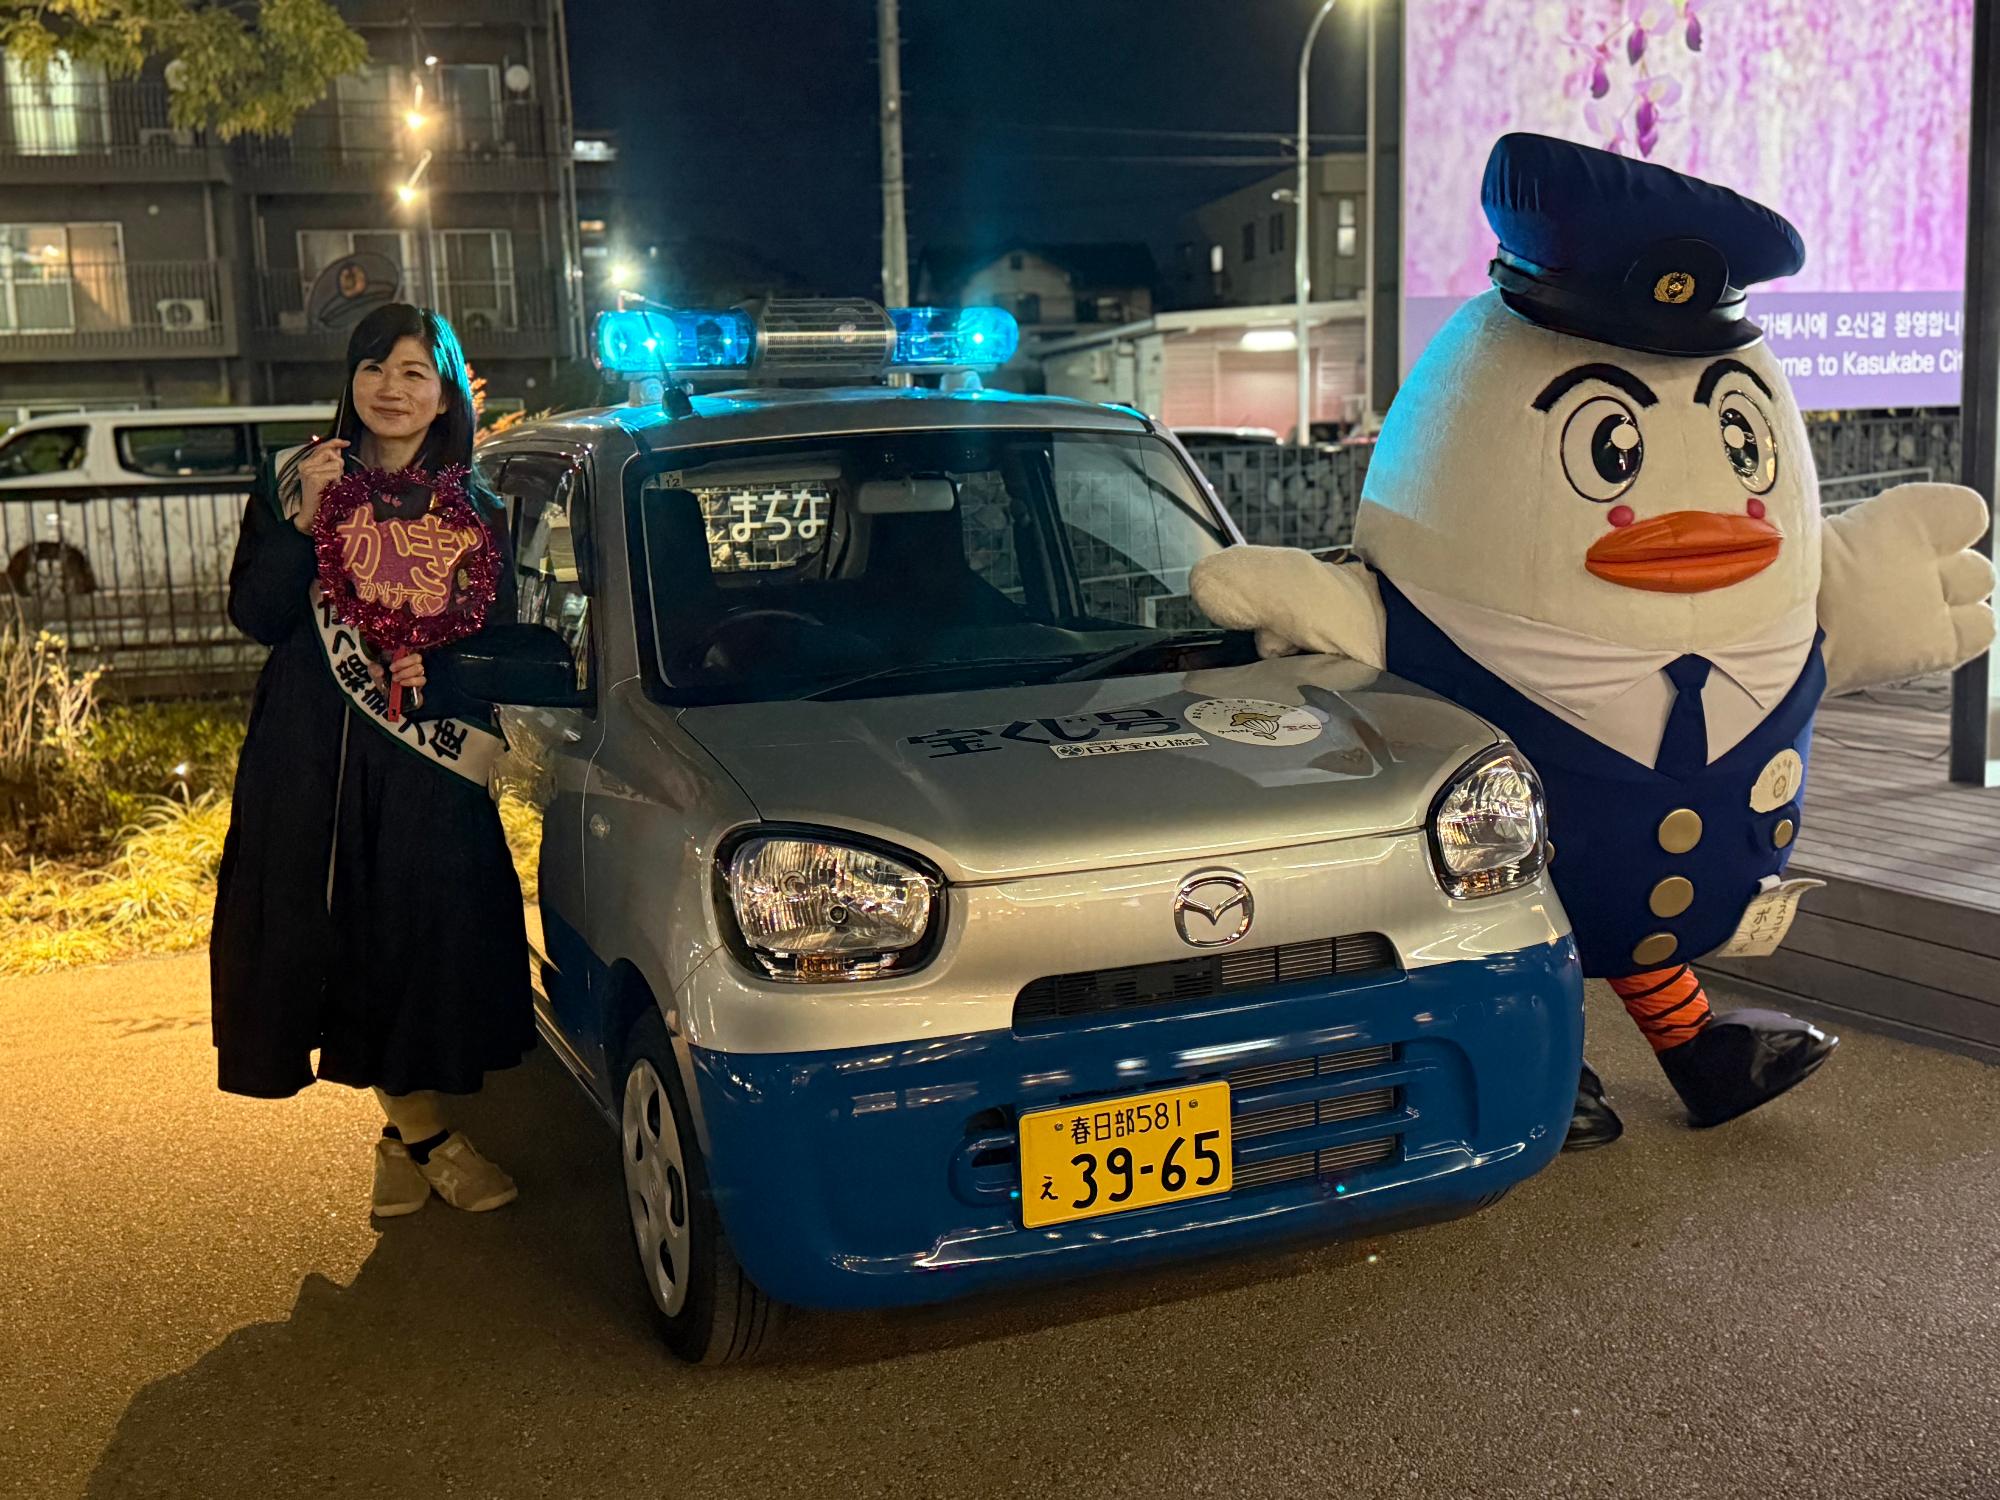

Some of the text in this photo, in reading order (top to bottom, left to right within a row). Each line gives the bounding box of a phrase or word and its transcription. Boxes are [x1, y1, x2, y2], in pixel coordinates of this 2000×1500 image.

[1757, 311, 1828, 340] 가베시에
[1894, 309, 1964, 338] 환영합니
[1816, 353, 1838, 376] to
[1843, 350, 1935, 376] Kasukabe
[336, 505, 478, 596] かぎ
[908, 708, 1182, 759] 宝くじ号
[1040, 1129, 1221, 1210] え 39-65
